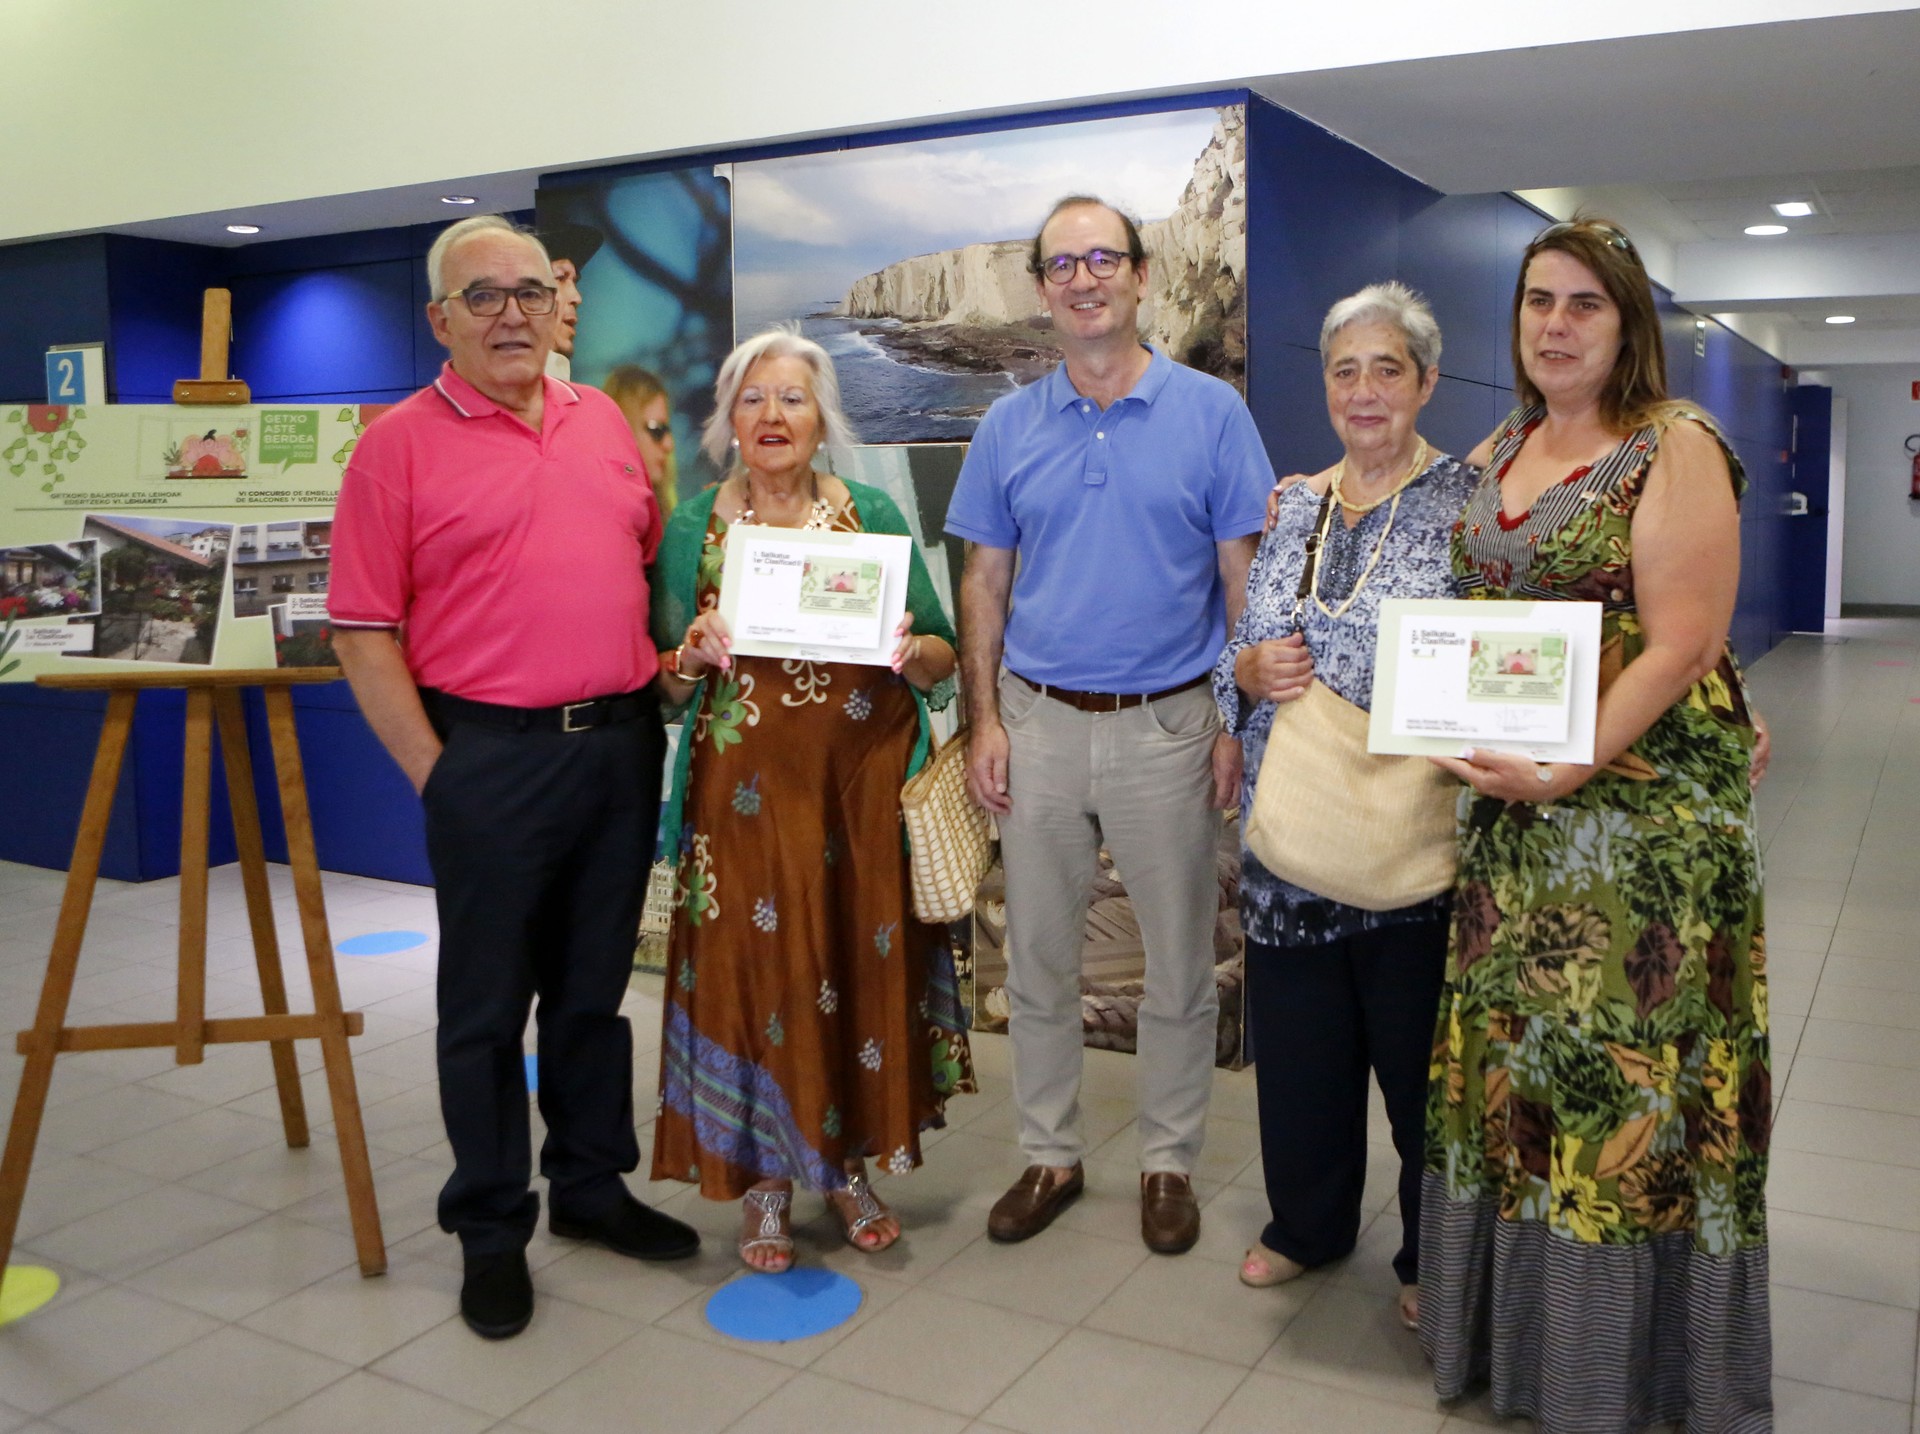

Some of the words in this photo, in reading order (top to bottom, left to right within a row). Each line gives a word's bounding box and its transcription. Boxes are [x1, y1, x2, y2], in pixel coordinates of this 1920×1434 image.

[57, 358, 75, 397] 2
[264, 414, 307, 423] GETXO
[264, 424, 297, 434] ASTE
[263, 434, 315, 444] BERDEA
[131, 491, 146, 499] ETA
